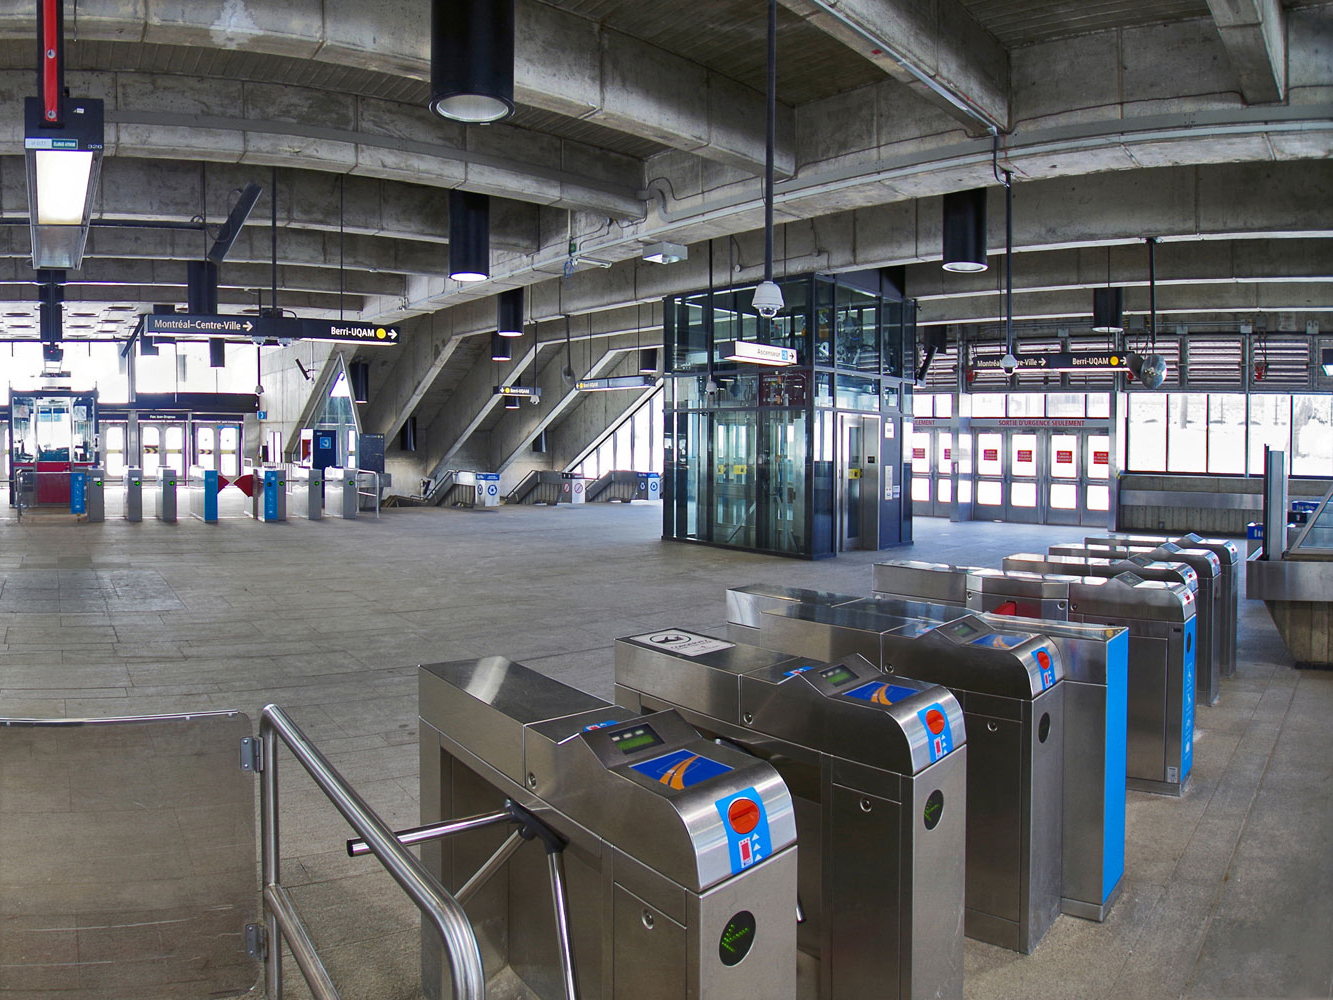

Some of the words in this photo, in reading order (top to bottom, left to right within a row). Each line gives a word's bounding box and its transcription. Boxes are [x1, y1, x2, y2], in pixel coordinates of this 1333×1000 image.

[330, 326, 375, 338] Berri-UQAM
[757, 348, 781, 357] Ascenseur
[1072, 356, 1109, 366] Berri-UQAM
